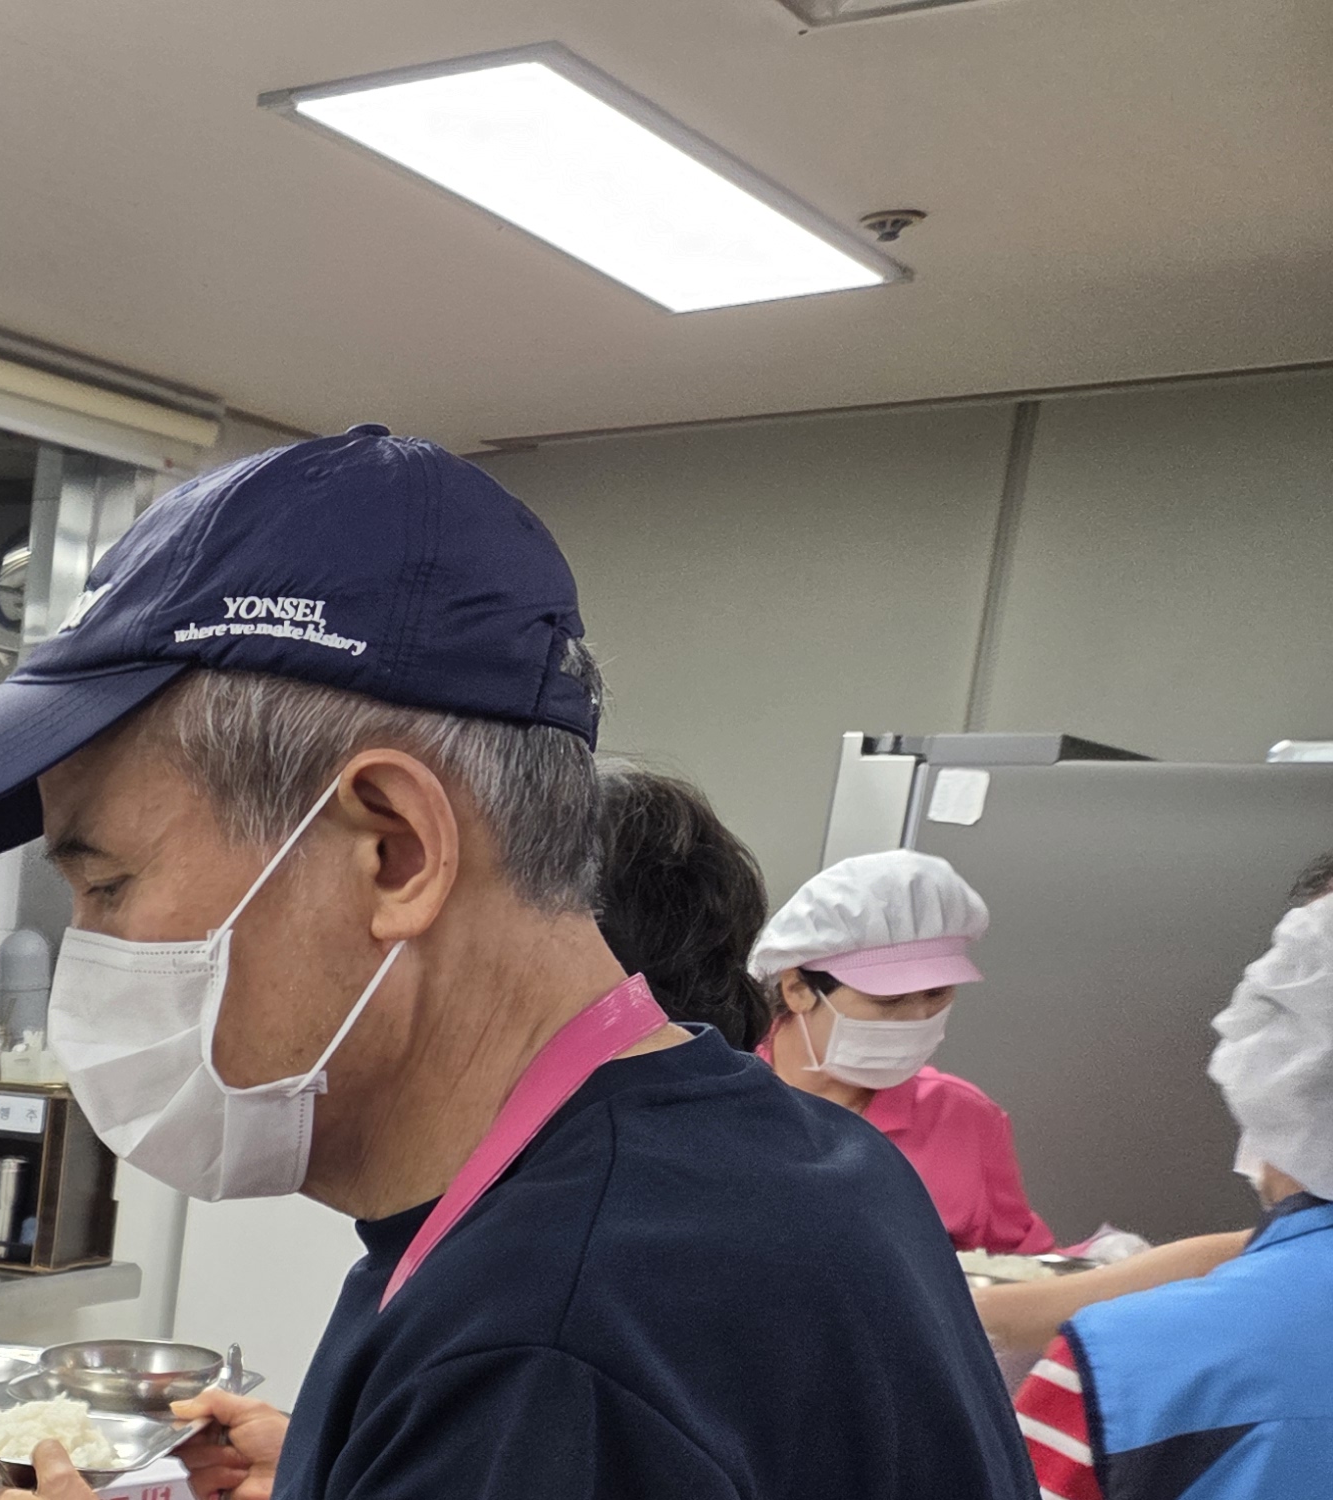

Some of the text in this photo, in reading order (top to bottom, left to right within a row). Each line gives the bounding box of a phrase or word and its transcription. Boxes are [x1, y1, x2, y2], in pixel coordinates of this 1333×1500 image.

[174, 620, 368, 656] where we make history
